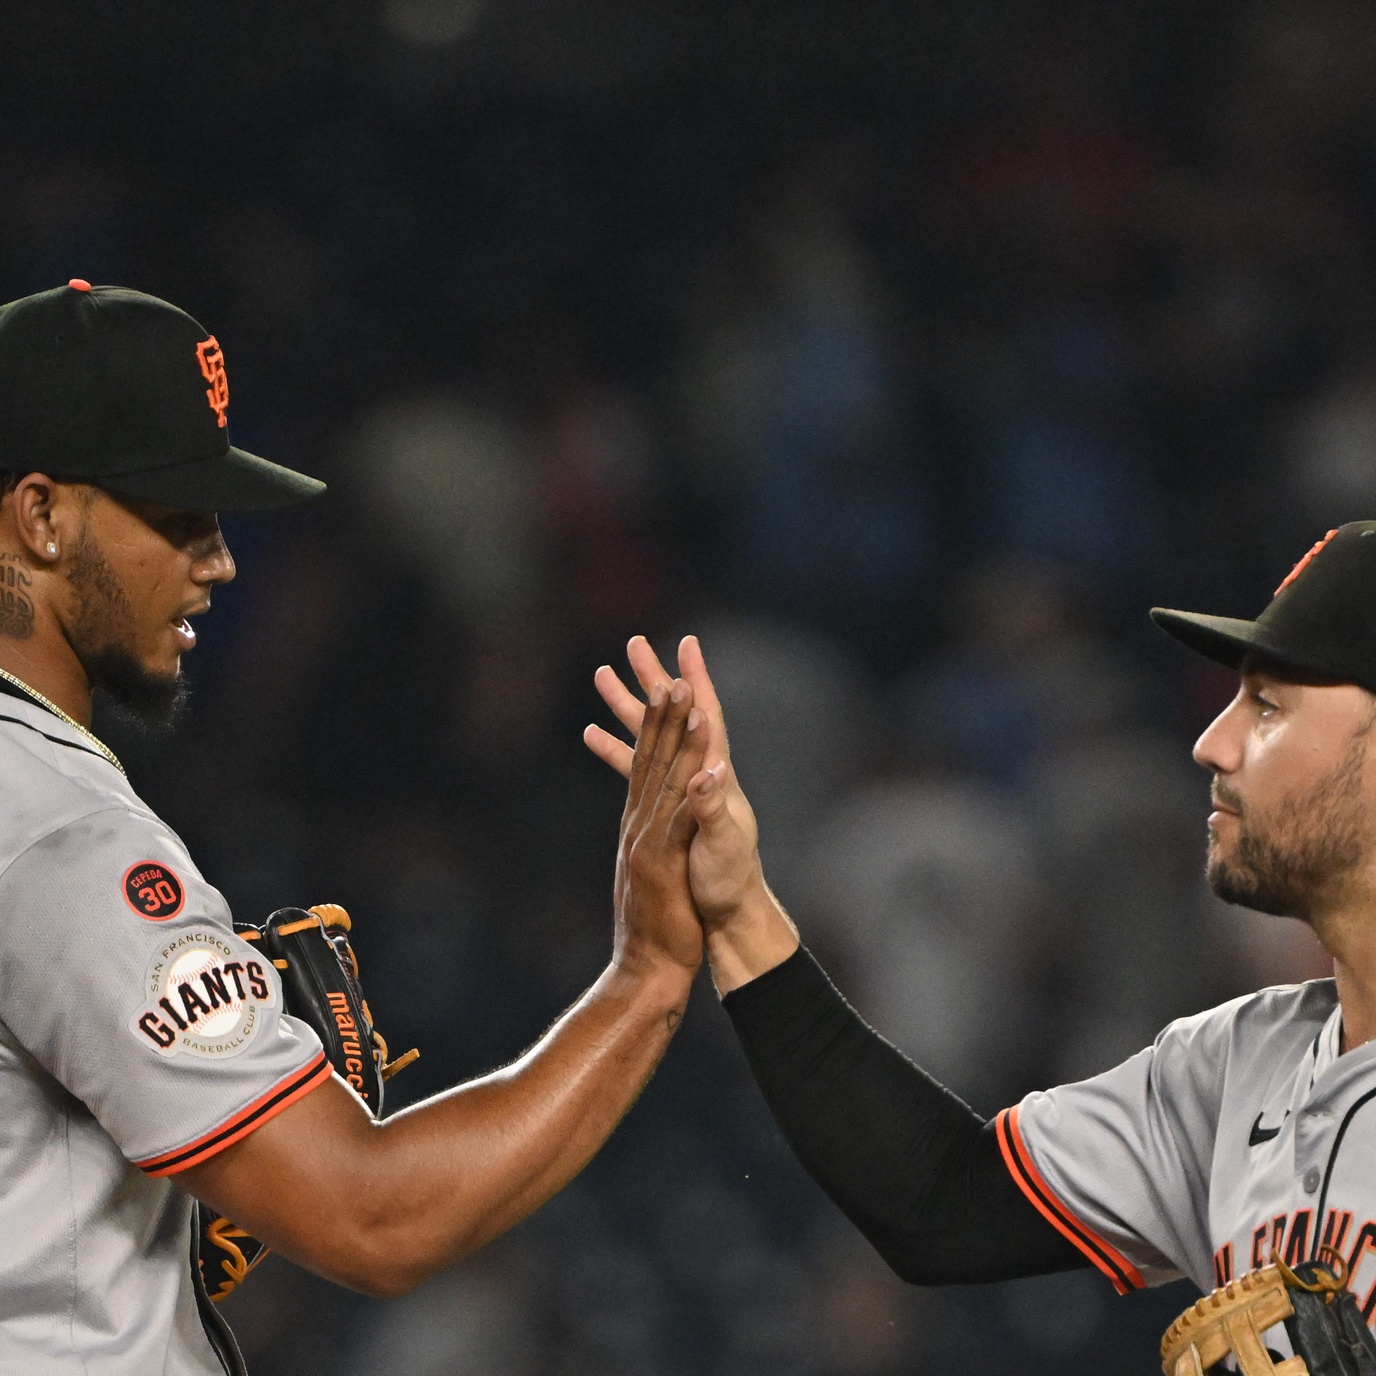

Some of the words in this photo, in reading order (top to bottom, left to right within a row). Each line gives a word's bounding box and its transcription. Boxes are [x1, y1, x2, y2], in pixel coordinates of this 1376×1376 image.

[130, 869, 163, 889] CEPEDA
[138, 880, 177, 912] 30
[151, 962, 163, 992] SAN
[162, 933, 231, 959] FRANCISCO
[138, 960, 270, 1049] GIANTS
[182, 1021, 244, 1053] BASEBALL
[242, 1005, 256, 1036] CLUB
